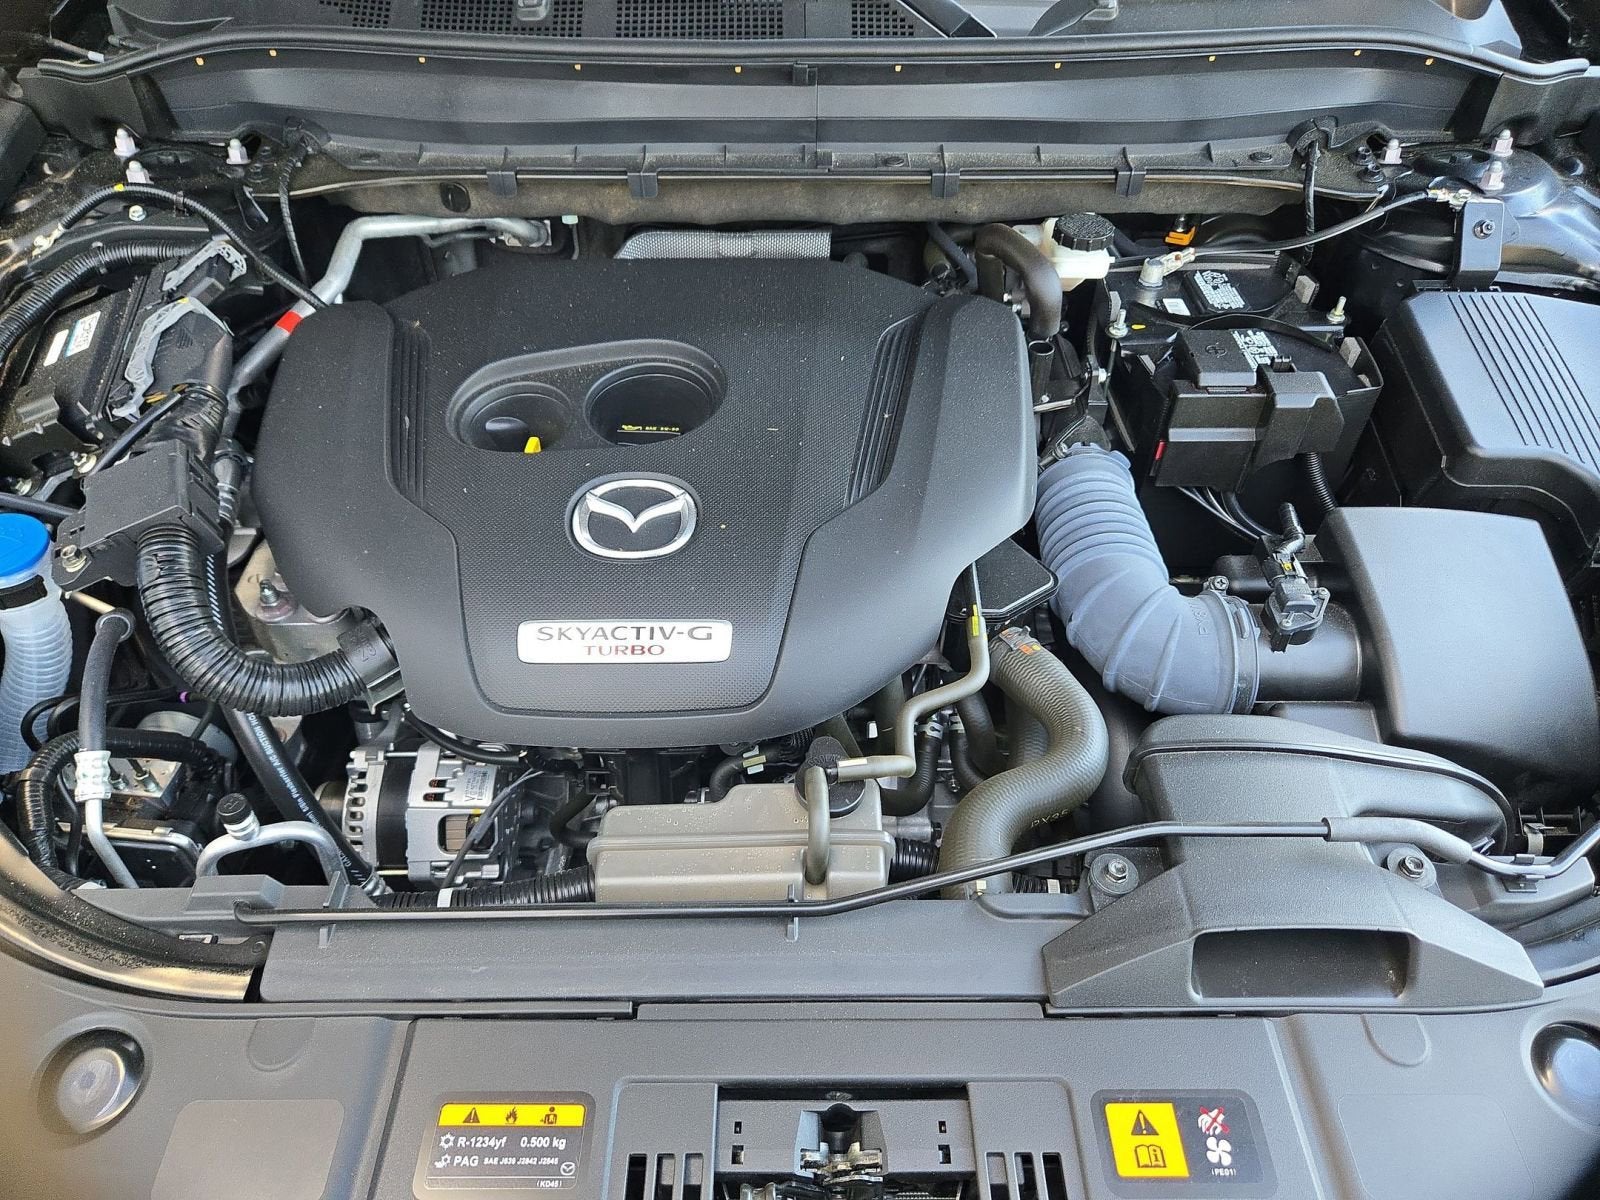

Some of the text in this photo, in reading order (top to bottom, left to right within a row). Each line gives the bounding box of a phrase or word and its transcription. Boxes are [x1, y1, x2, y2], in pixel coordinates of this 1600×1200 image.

[536, 625, 713, 641] SKYACTIV-G
[584, 644, 665, 656] TURBO
[457, 1136, 566, 1150] R-1234yf 0.500 kg
[453, 1155, 479, 1167] PAG
[483, 1157, 499, 1165] SAE
